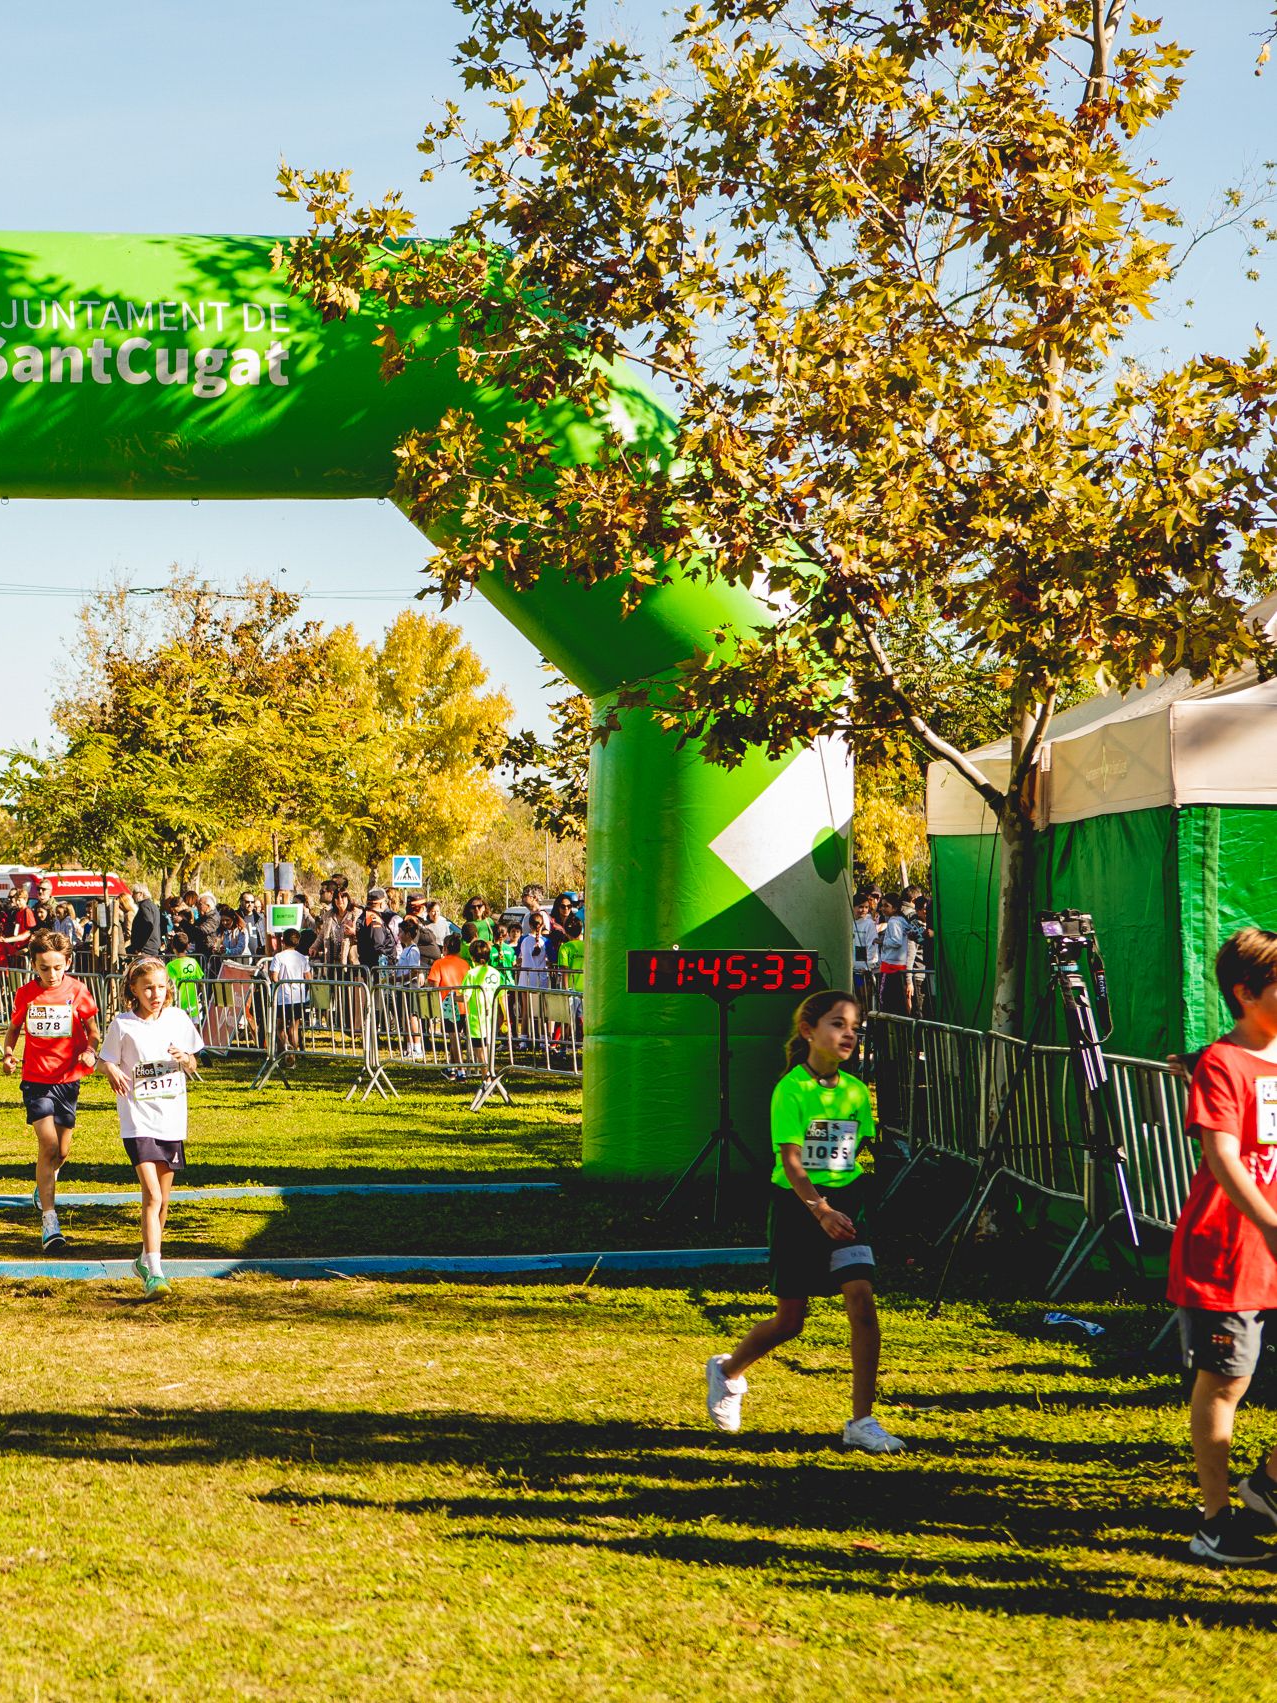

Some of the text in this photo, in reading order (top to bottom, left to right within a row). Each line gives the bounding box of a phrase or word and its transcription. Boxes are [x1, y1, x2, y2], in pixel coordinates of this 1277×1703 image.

[242, 302, 290, 332] DE
[648, 955, 813, 990] 11:45:33
[36, 1022, 61, 1031] 878
[142, 1078, 173, 1091] 1317
[807, 1145, 849, 1160] 1055
